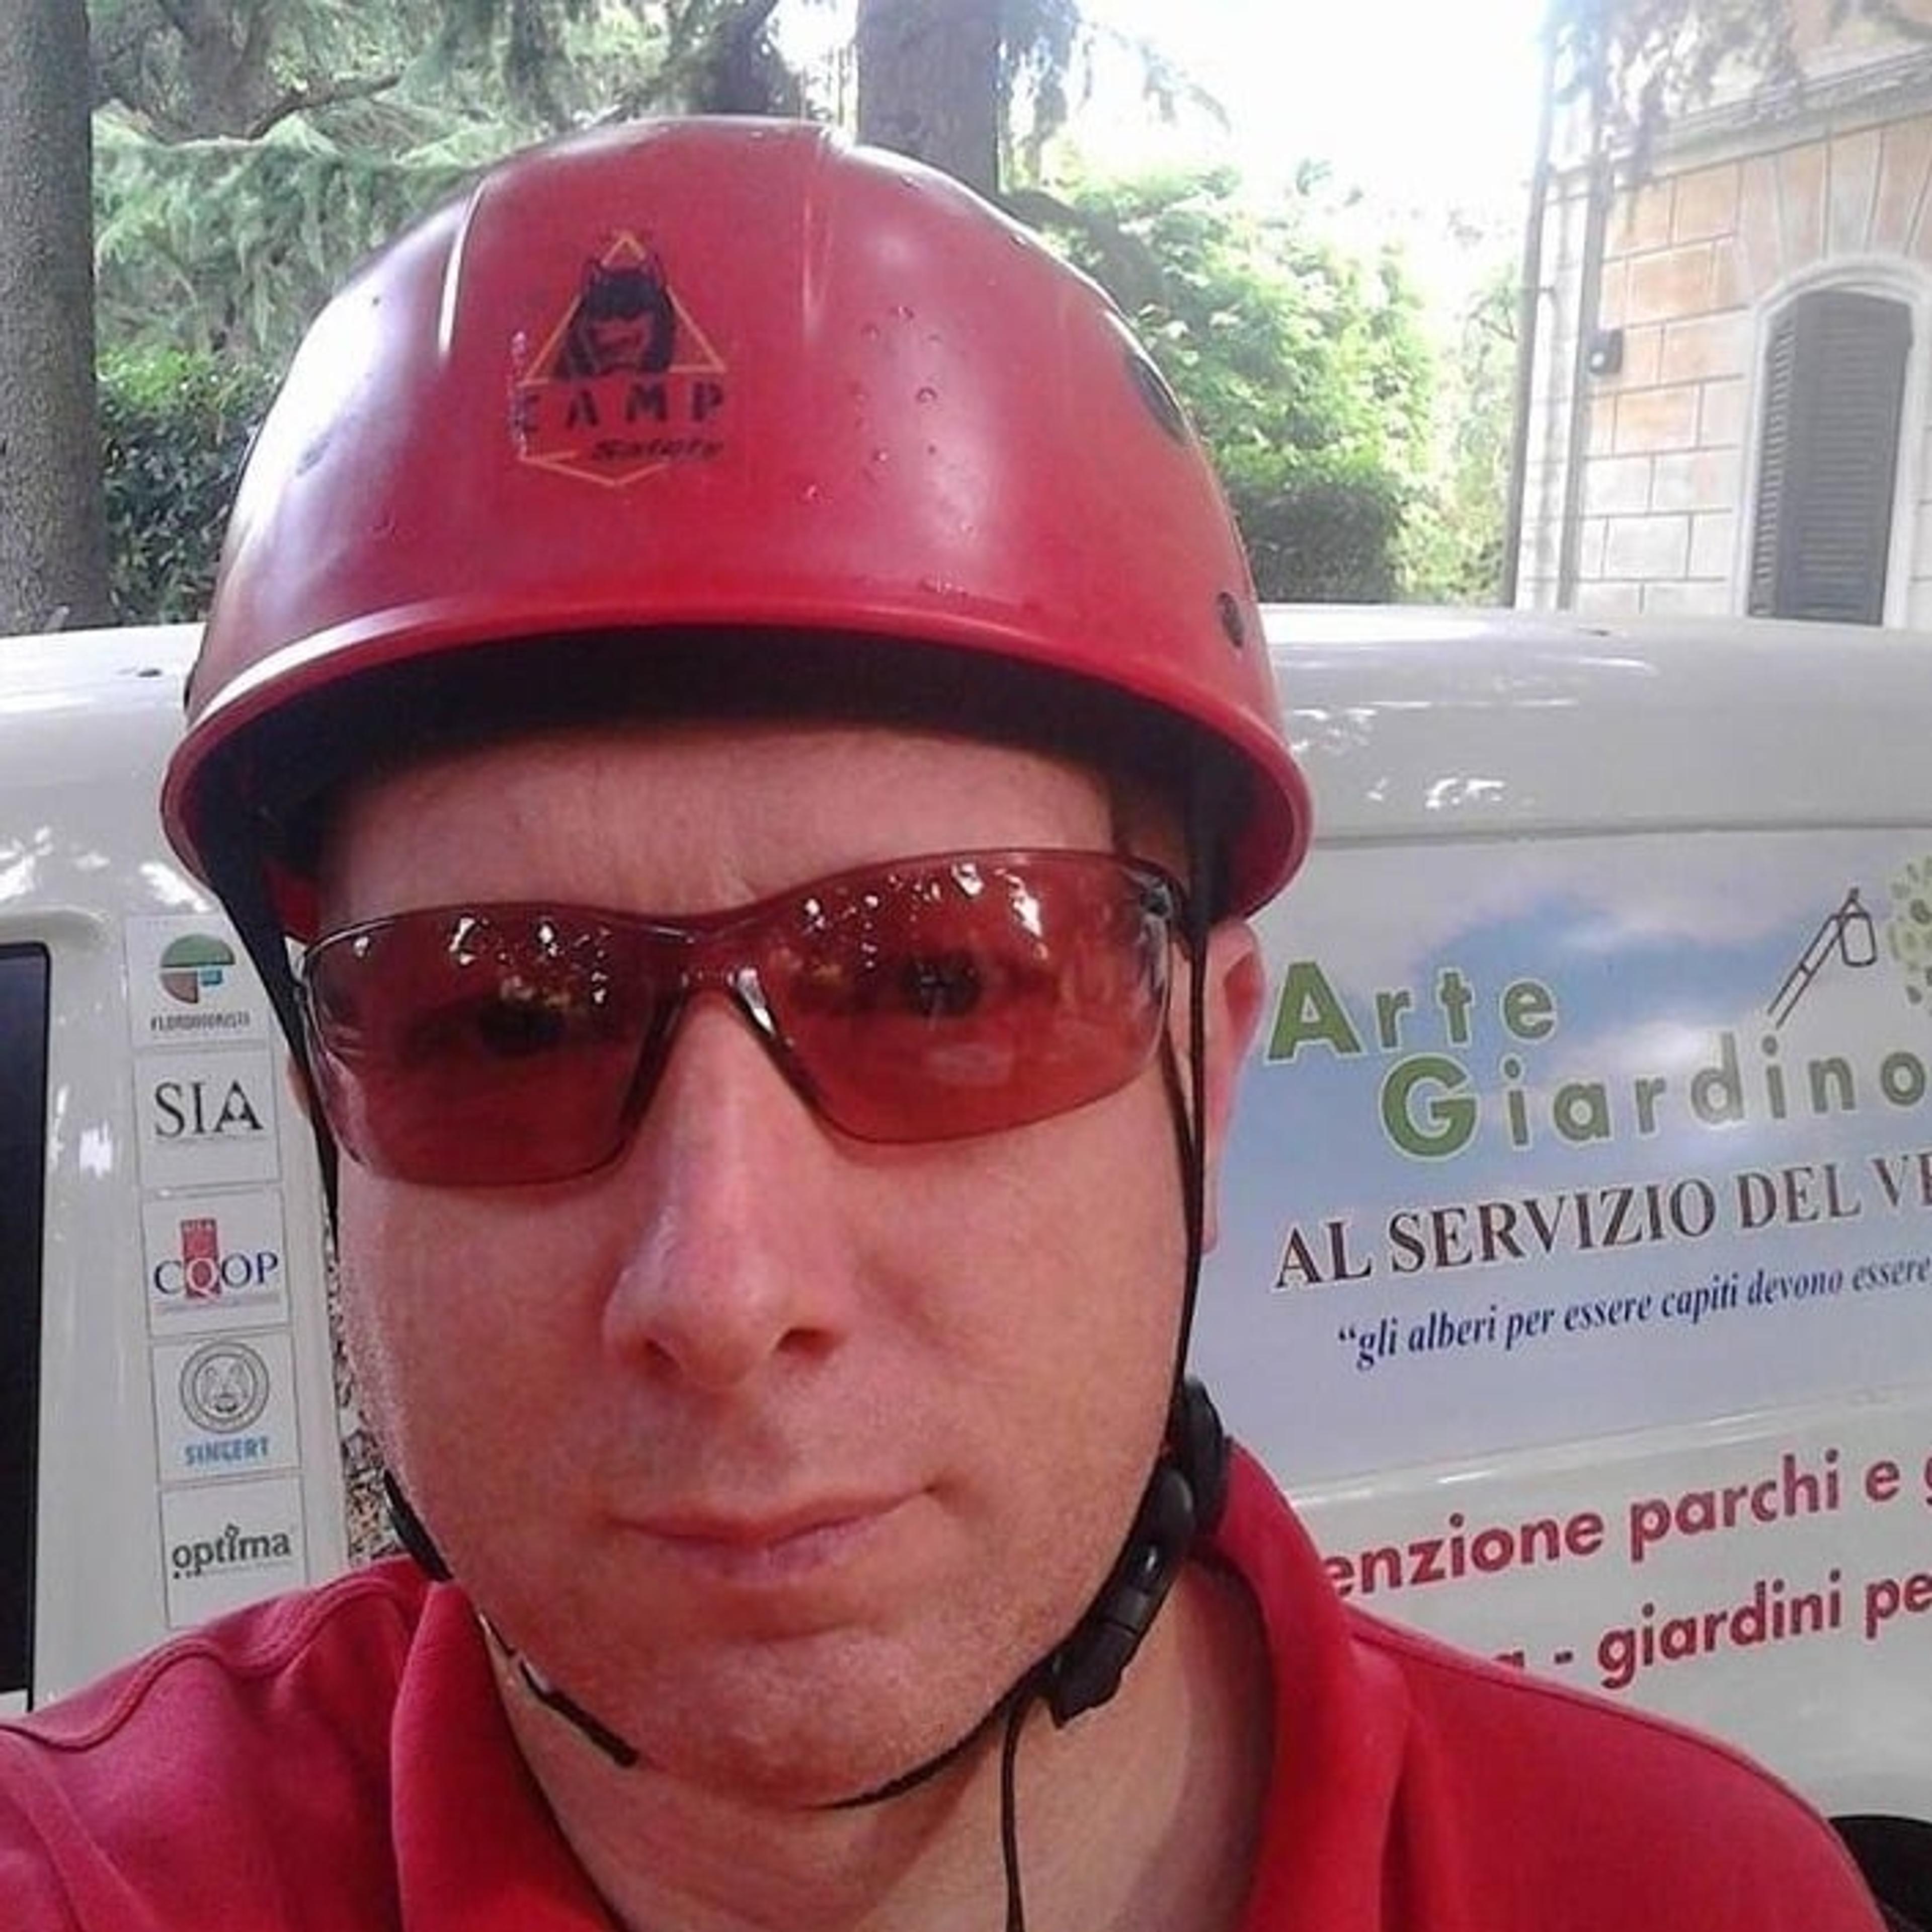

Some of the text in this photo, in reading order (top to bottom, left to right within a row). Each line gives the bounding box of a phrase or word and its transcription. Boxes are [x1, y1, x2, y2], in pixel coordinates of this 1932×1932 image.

[518, 381, 725, 434] CAMP
[1267, 960, 1555, 1062] Arte
[154, 1080, 264, 1138] SIA
[1381, 1032, 1926, 1158] Giardino
[1276, 1221, 1372, 1288] AL
[1387, 1177, 1717, 1274] SERVIZIO
[1736, 1163, 1862, 1230] DEL
[1408, 1305, 1496, 1354] alberi
[1505, 1311, 1556, 1350] per
[1564, 1294, 1652, 1332] essere
[1662, 1272, 1740, 1324] capiti
[1747, 1267, 1843, 1307] devono
[1852, 1256, 1931, 1292] essere
[172, 1522, 292, 1577] optima
[1323, 1511, 1604, 1597] enzione
[1630, 1448, 1839, 1562] parchi
[1866, 1460, 1901, 1502] e
[1597, 1569, 1841, 1689] giardini
